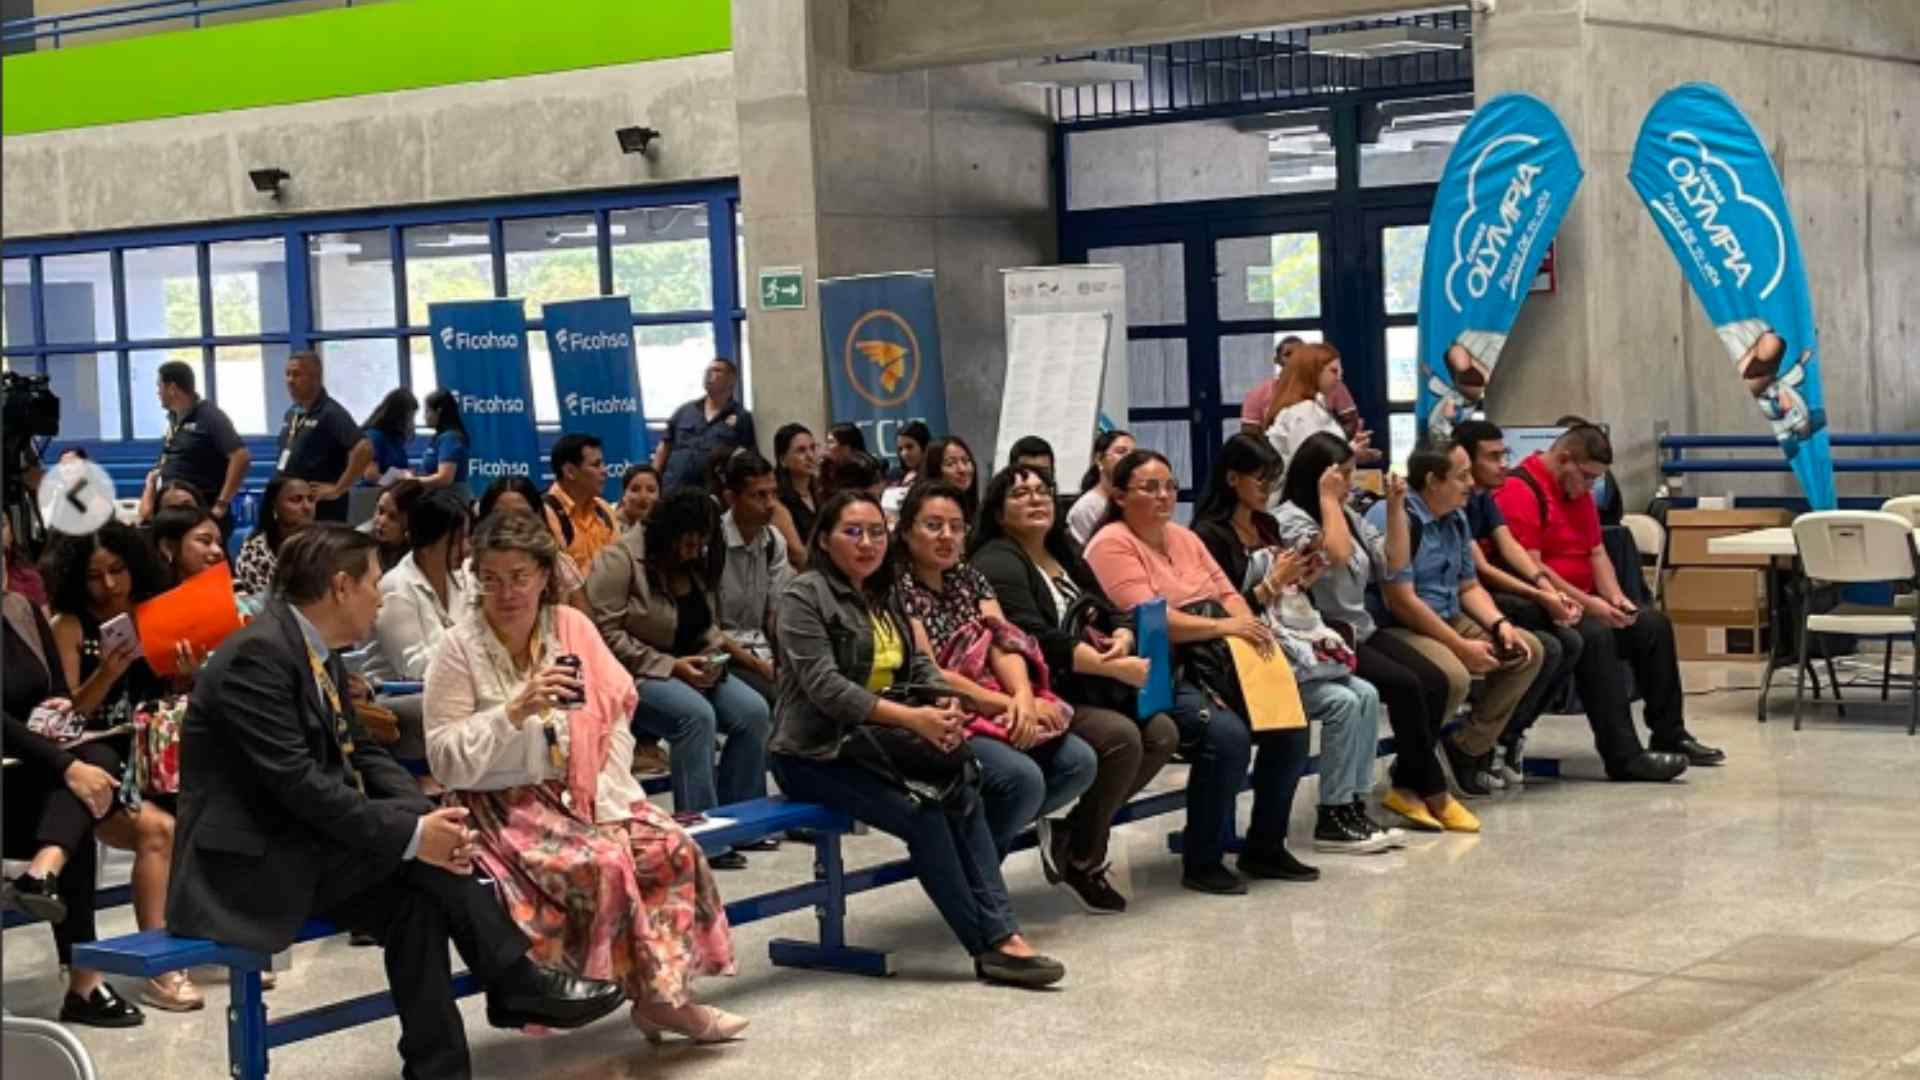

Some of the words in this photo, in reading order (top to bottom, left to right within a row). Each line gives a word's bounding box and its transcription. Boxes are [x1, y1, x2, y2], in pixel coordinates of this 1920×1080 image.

[1467, 164, 1543, 297] OLYMPIA
[1667, 157, 1751, 288] OLYMPIA
[456, 331, 519, 350] Ficohsa
[570, 331, 629, 350] Ficohsa
[463, 394, 524, 413] Ficohsa
[468, 458, 529, 476] Ficohsa
